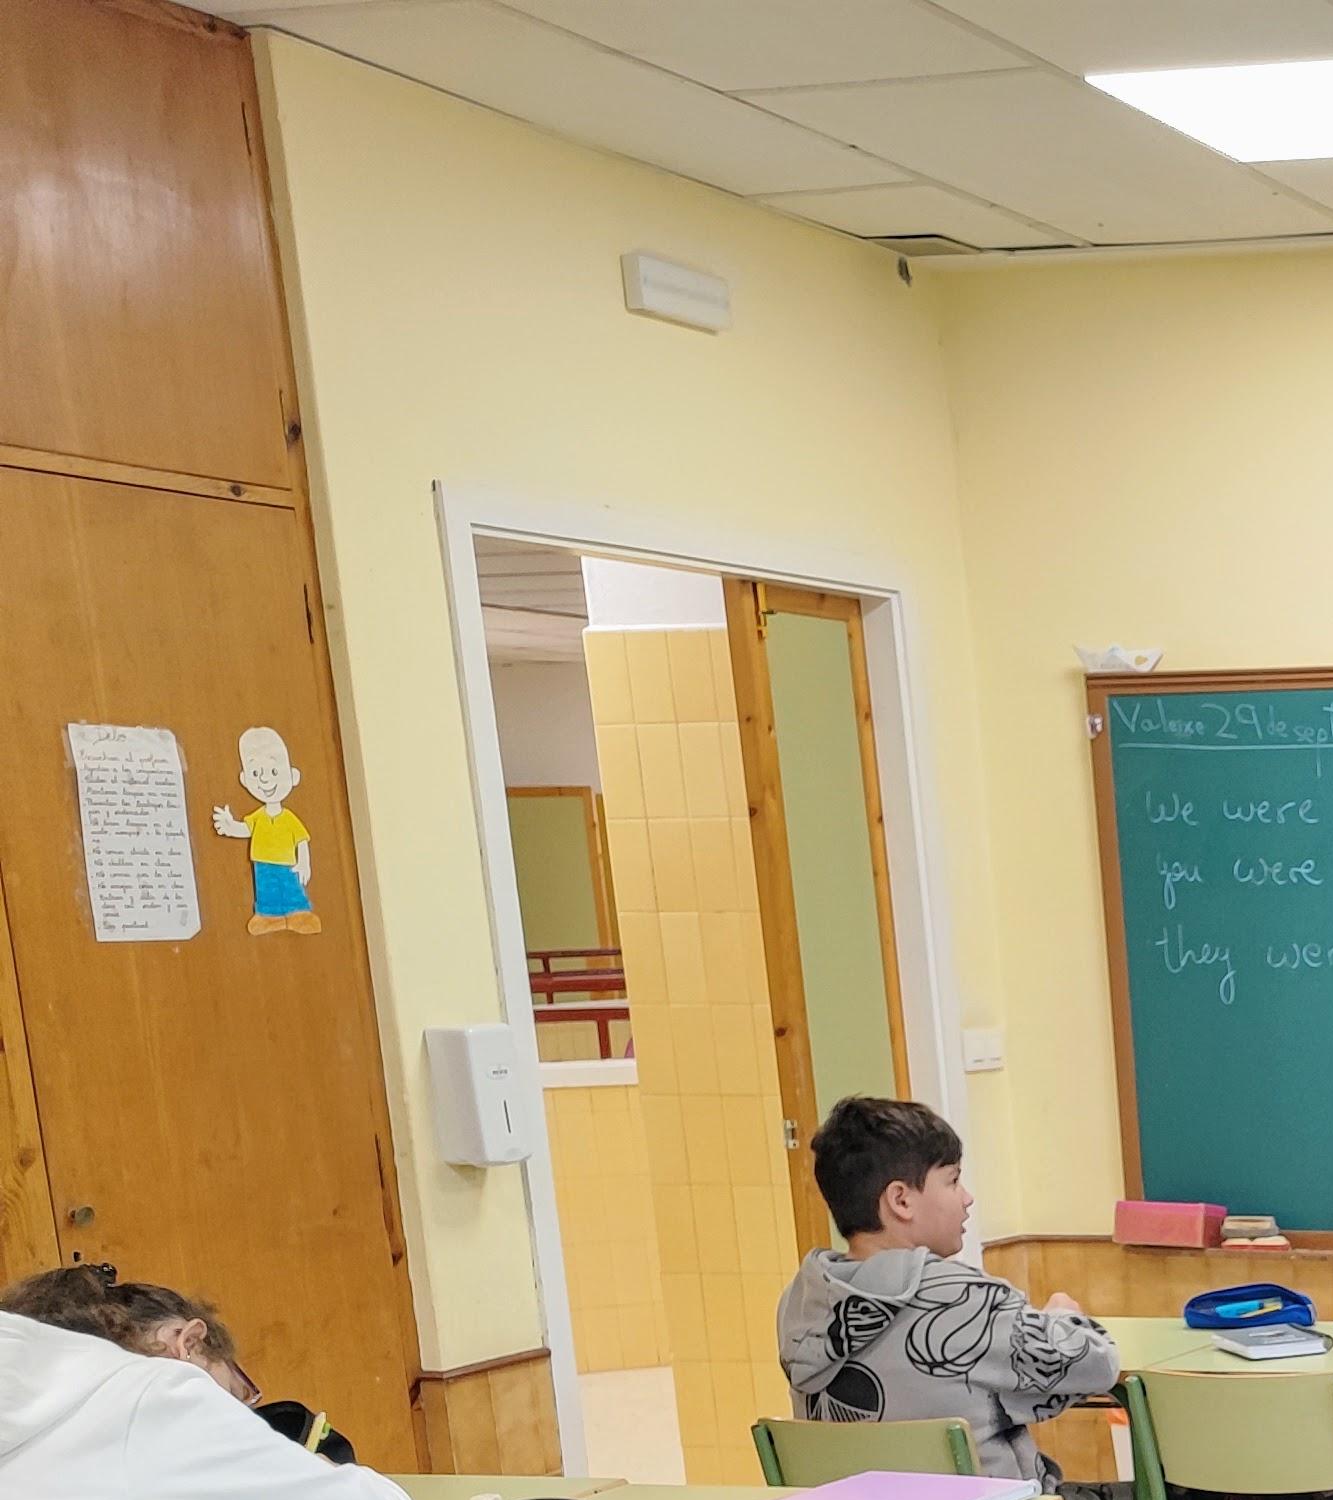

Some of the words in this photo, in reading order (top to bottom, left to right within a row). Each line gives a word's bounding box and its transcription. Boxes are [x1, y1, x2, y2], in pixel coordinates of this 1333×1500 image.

[1201, 703, 1263, 739] 29
[1267, 704, 1289, 737] de
[1223, 798, 1319, 825] were
[1156, 854, 1202, 911] you
[1233, 857, 1324, 886] were
[1155, 925, 1237, 1004] they
